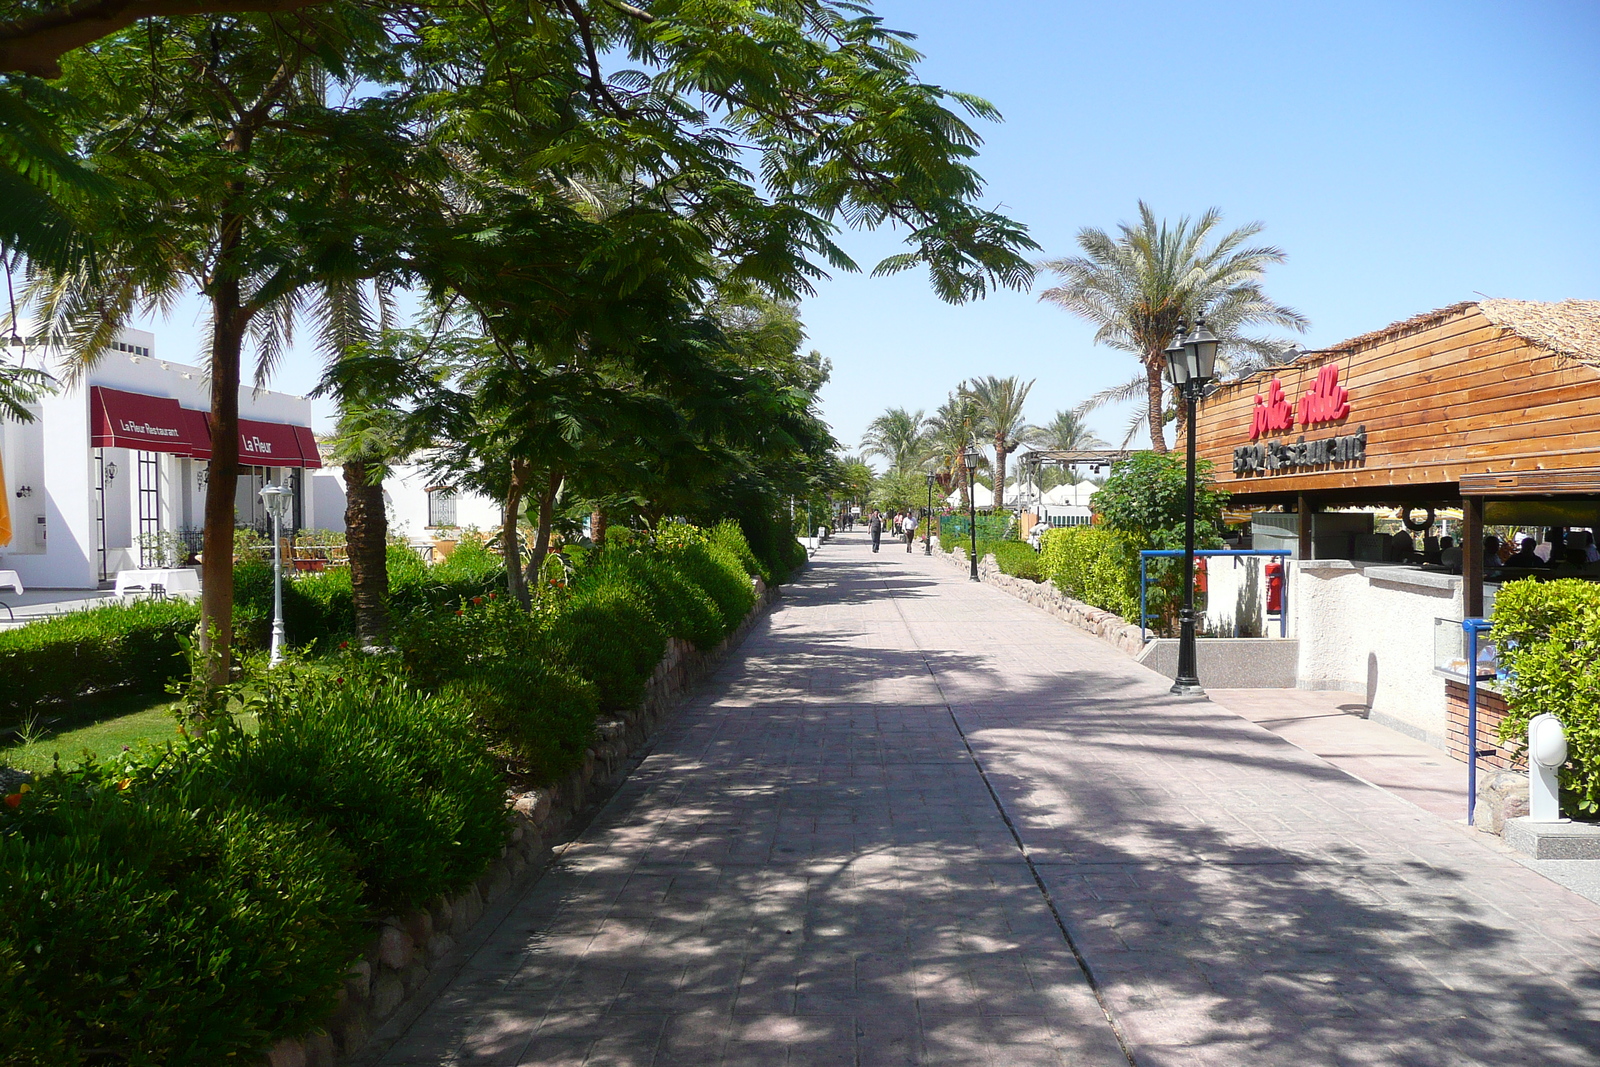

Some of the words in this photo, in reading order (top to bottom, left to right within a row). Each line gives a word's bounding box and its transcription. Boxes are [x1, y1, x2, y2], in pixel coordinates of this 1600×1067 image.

[1298, 364, 1350, 424] ville
[119, 419, 130, 432] La
[129, 420, 145, 434] Fleur
[144, 422, 179, 437] Restaurant
[241, 434, 253, 452] La
[252, 436, 272, 454] Fleur
[1266, 425, 1367, 470] Restaurant
